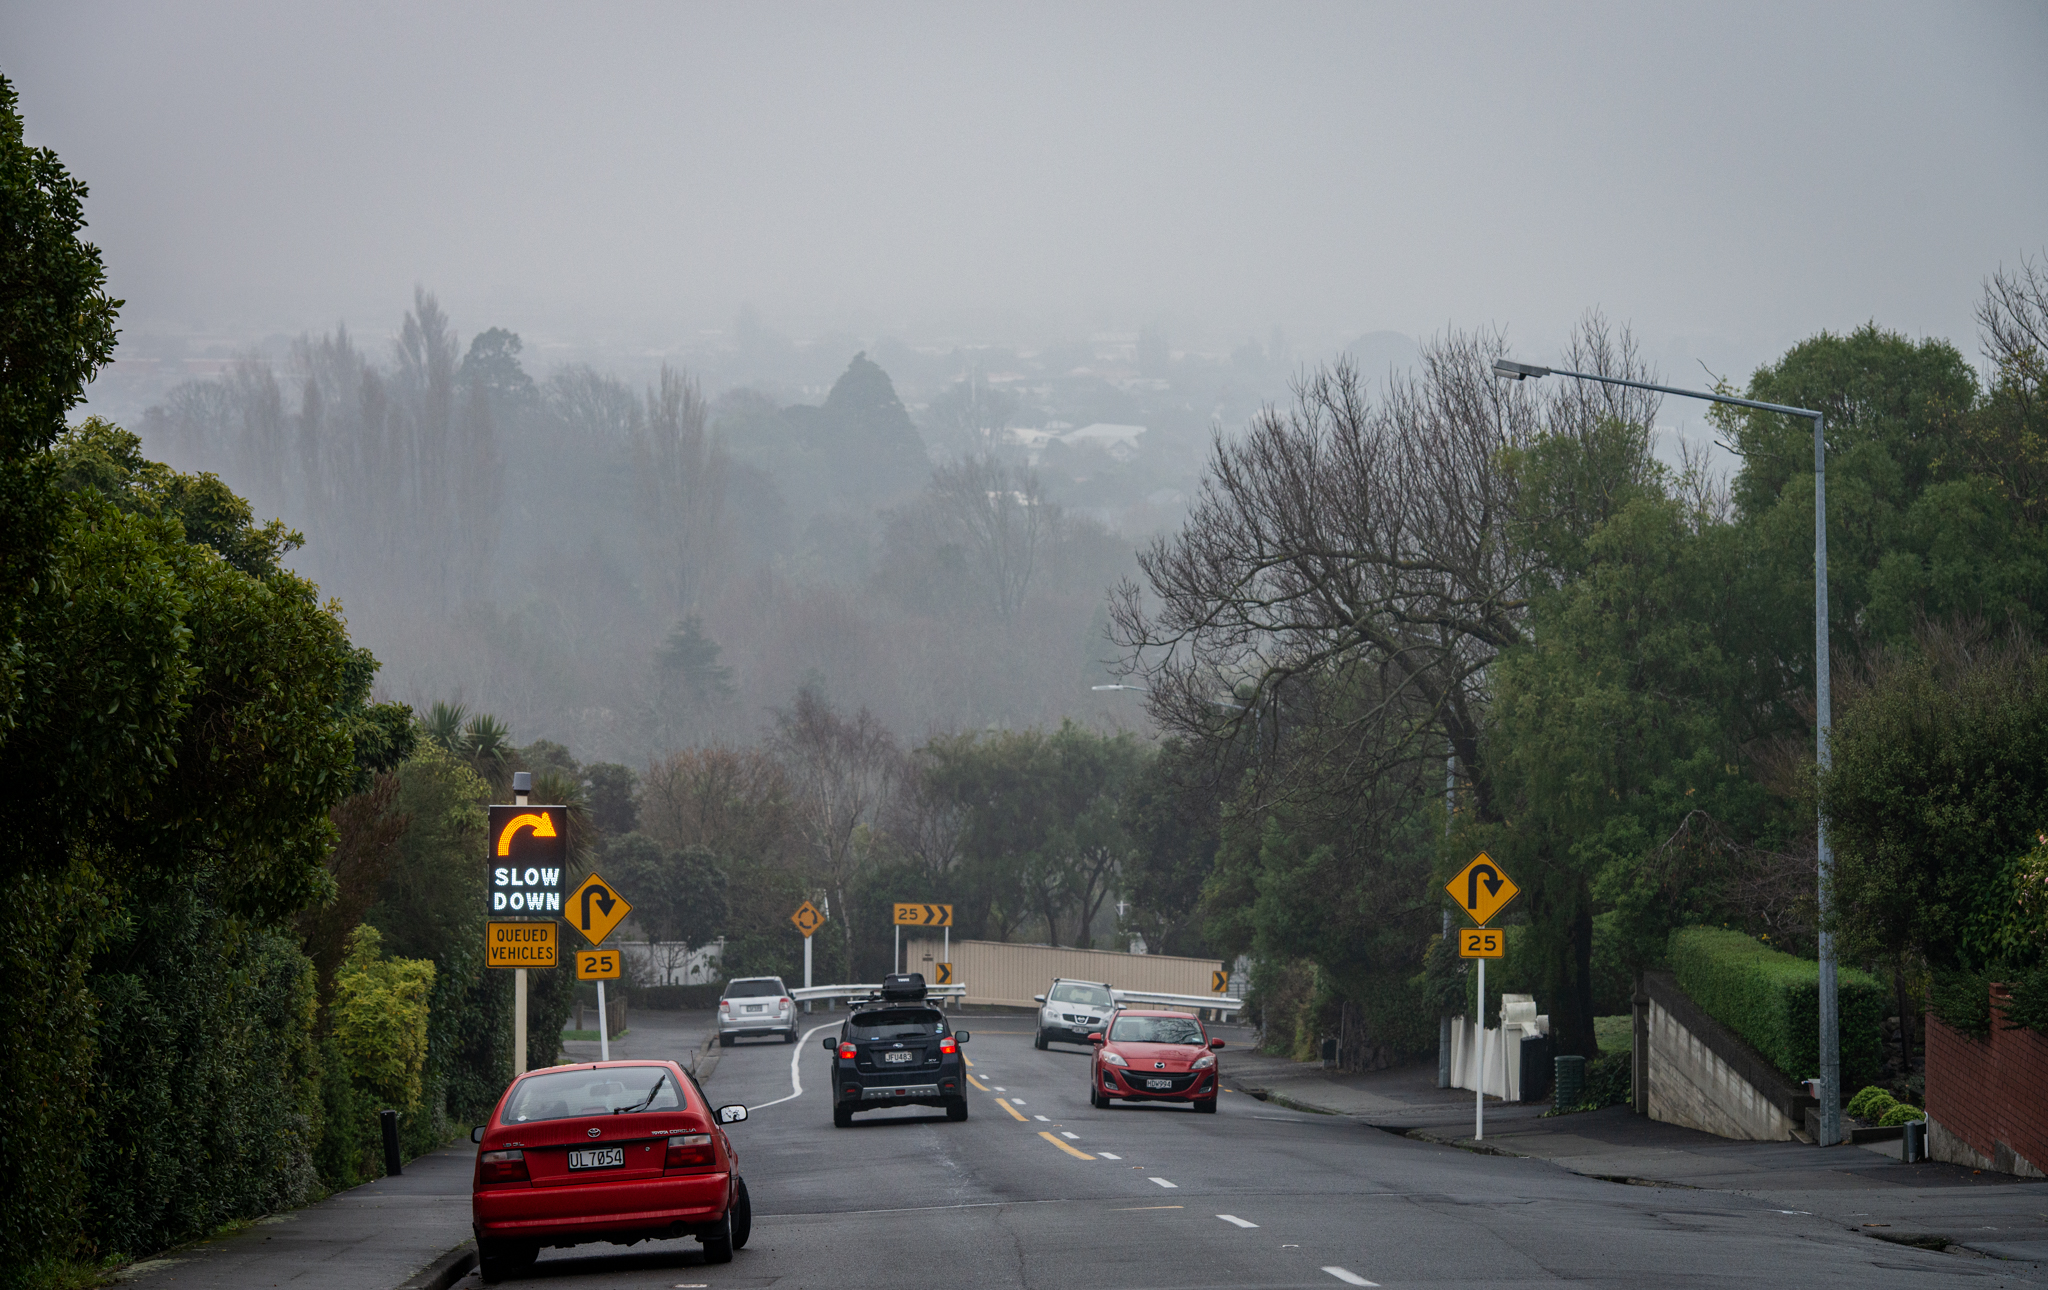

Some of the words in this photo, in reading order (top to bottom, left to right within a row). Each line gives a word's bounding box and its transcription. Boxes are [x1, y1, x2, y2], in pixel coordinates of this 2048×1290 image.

[495, 868, 559, 886] SLOW
[494, 892, 559, 910] DOWN
[898, 908, 918, 920] 25
[497, 929, 548, 942] QUEUED
[1468, 935, 1496, 951] 25
[491, 947, 553, 959] VEHICLES
[585, 957, 612, 973] 25
[886, 1053, 912, 1061] JFU483
[570, 1150, 622, 1167] UL7054
